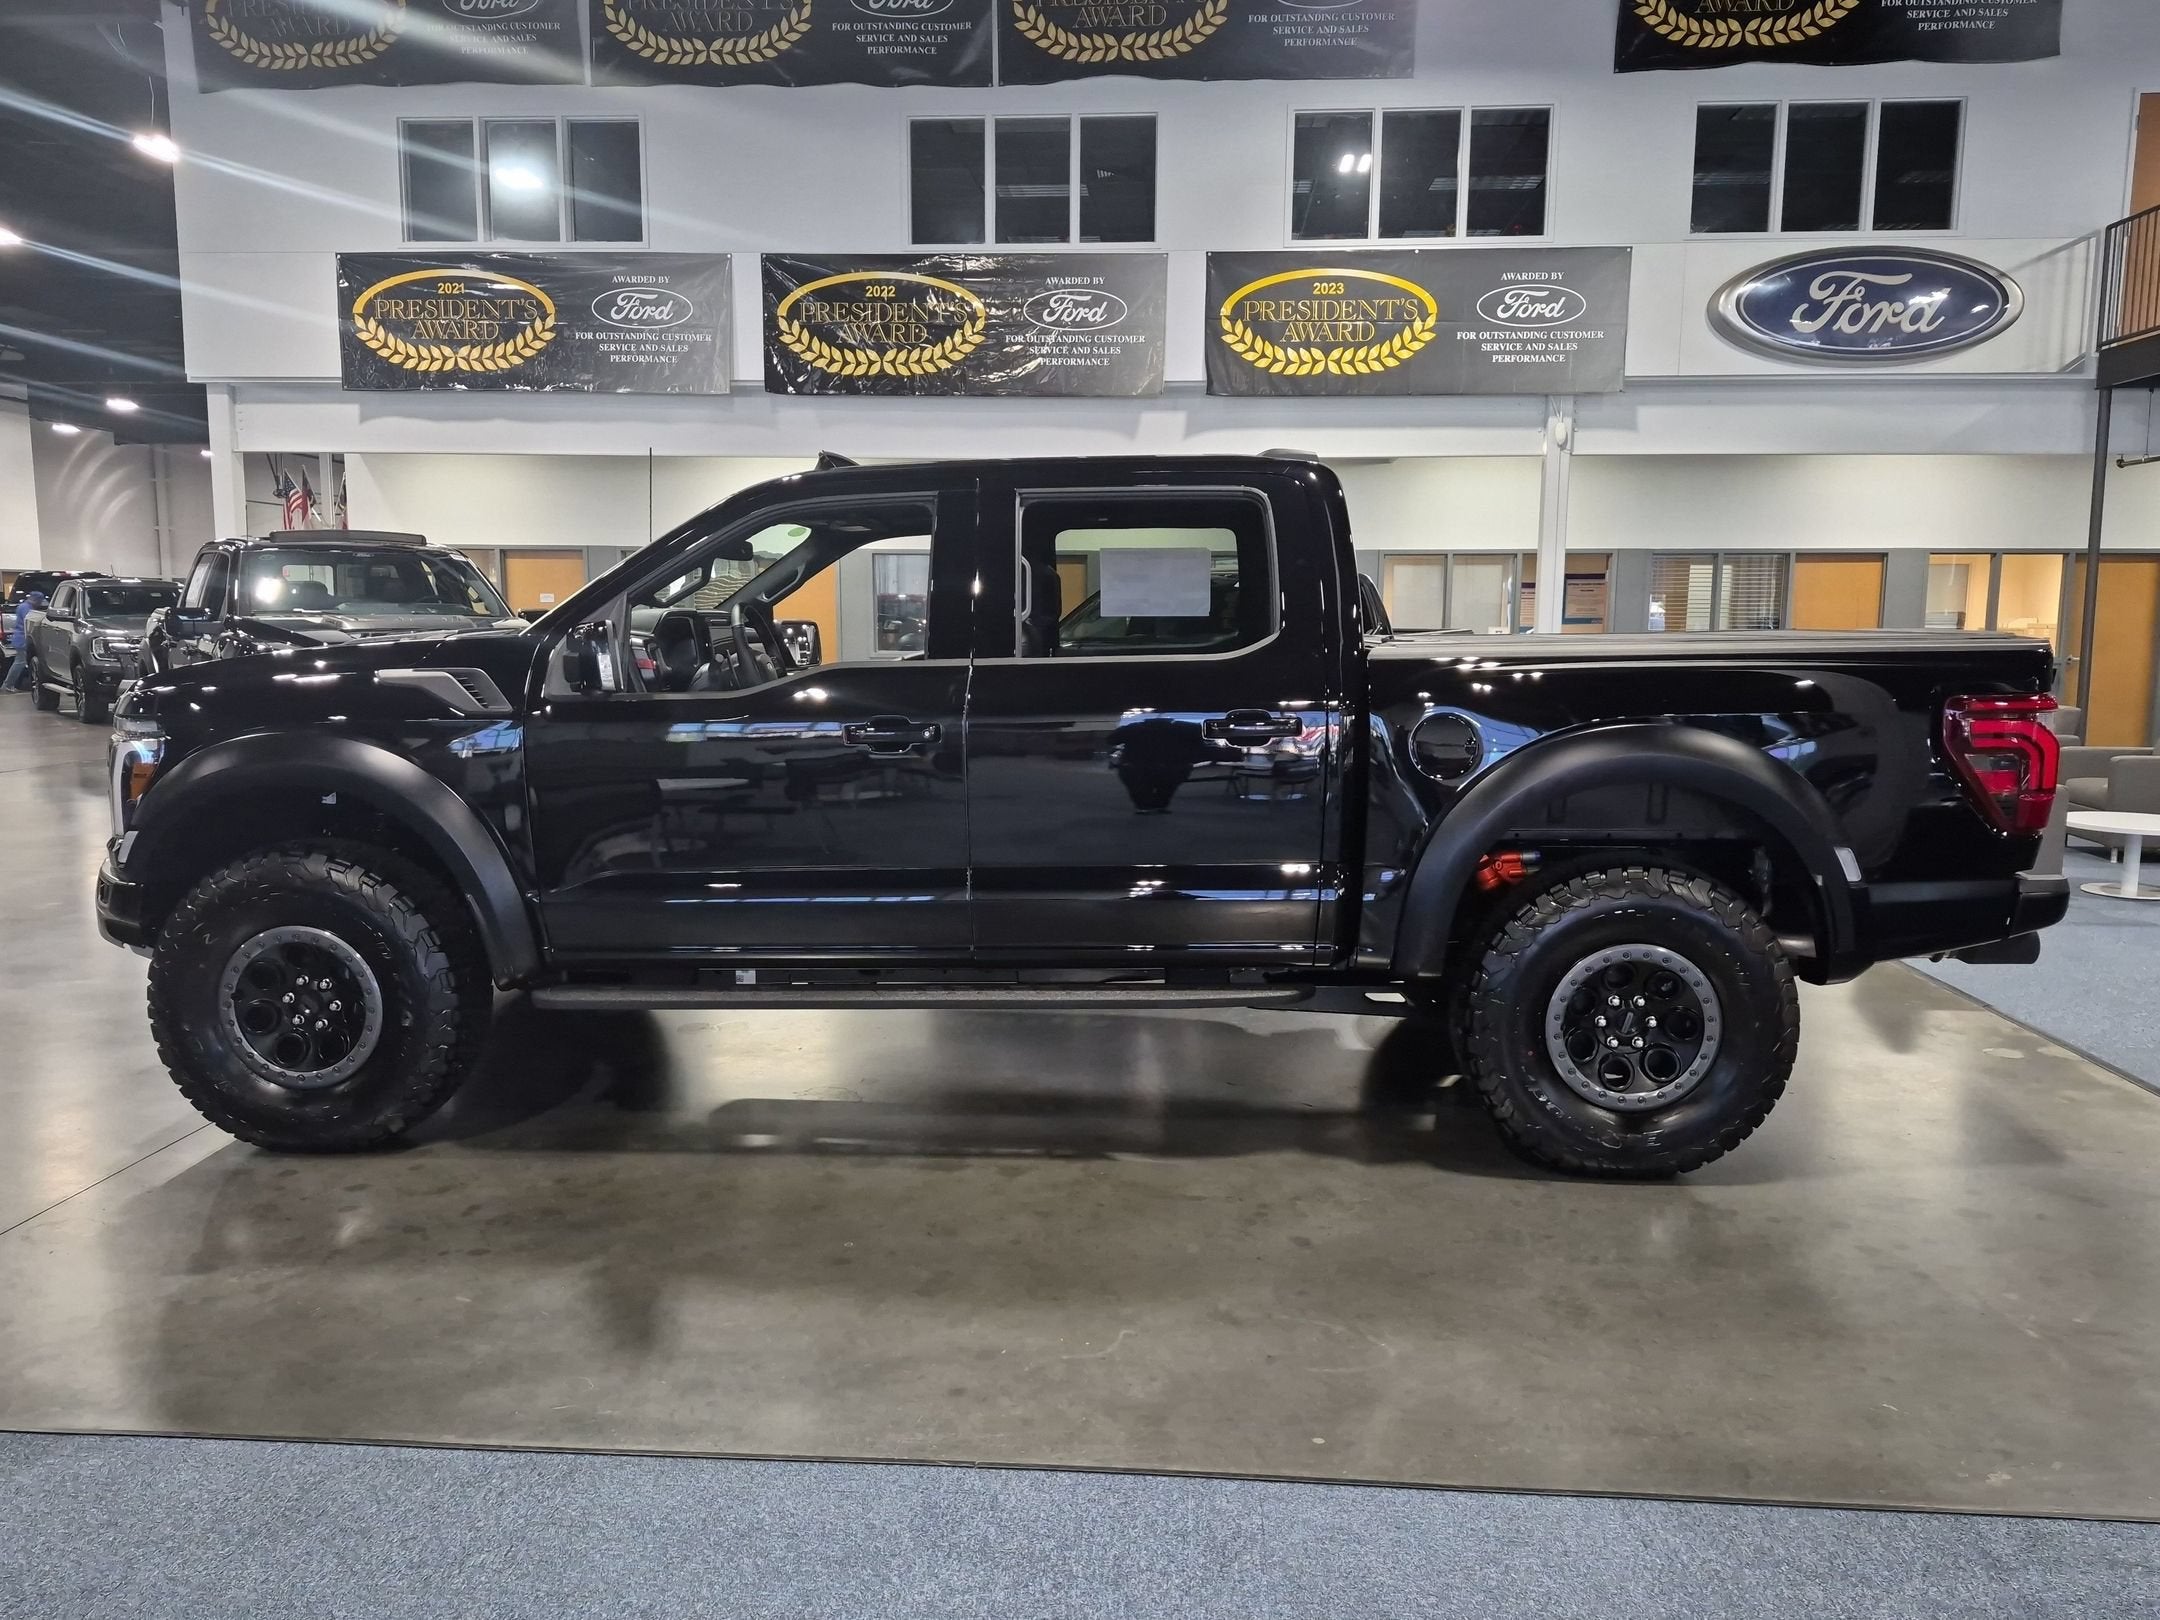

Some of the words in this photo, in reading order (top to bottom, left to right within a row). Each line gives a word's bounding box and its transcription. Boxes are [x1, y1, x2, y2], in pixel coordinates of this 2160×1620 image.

[1072, 5, 1167, 29] AWARD
[1248, 14, 1268, 23] FOR
[1270, 13, 1338, 22] OUTSTANDING
[1341, 12, 1395, 21] CUSTOMER
[1906, 9, 1951, 19] SERVICE
[1954, 8, 1976, 17] AND
[1978, 8, 2009, 17] SALES
[510, 21, 561, 31] CUSTOMER
[663, 11, 753, 32] AWARD
[832, 22, 851, 31] FOR
[853, 22, 919, 31] OUTSTANDING
[921, 21, 972, 31] CUSTOMER
[1917, 20, 1995, 31] PERFORMANCE
[1273, 26, 1314, 35] SERVICE
[1316, 25, 1337, 34] AND
[1339, 24, 1369, 33] SALES
[492, 34, 509, 43] AND
[511, 33, 537, 42] SALES
[856, 34, 895, 43] SERVICE
[898, 34, 917, 43] AND
[919, 35, 948, 43] SALES
[1284, 37, 1358, 47] PERFORMANCE
[461, 47, 529, 55] PERFORMANCE
[867, 46, 937, 55] PERFORMANCE
[612, 275, 656, 284] AWARDED
[658, 275, 671, 284] BY
[1045, 276, 1091, 285] AWARDED
[1093, 276, 1105, 285] BY
[1501, 272, 1549, 281] AWARDED
[1550, 272, 1564, 280] BY
[437, 282, 465, 294] 2021
[865, 286, 896, 297] 2022
[1312, 282, 1345, 295] 2023
[610, 292, 674, 320] Ford
[1496, 289, 1566, 319] Ford
[1792, 270, 1952, 334] Ford
[374, 299, 538, 320] PRESIDENT'S
[799, 302, 968, 323] PRESIDENT'S
[1042, 294, 1107, 322] Ford
[1242, 298, 1418, 322] PRESIDENT'S
[410, 319, 499, 340] AWARD
[836, 323, 927, 344] AWARD
[1280, 321, 1375, 343] AWARD
[575, 332, 594, 340] FOR
[595, 332, 659, 341] OUTSTANDING
[661, 333, 712, 342] CUSTOMER
[1005, 334, 1025, 343] FOR
[1027, 334, 1092, 343] OUTSTANDING
[1094, 334, 1146, 343] CUSTOMER
[1456, 331, 1477, 340] FOR
[1479, 331, 1548, 340] OUTSTANDING
[1550, 330, 1604, 339] CUSTOMER
[599, 343, 637, 351] SERVICE
[639, 344, 659, 352] AND
[660, 344, 689, 353] SALES
[1029, 346, 1069, 355] SERVICE
[1071, 346, 1091, 354] AND
[1092, 346, 1121, 354] SALES
[1481, 343, 1523, 351] SERVICE
[1525, 343, 1546, 351] AND
[1547, 342, 1578, 351] SALES
[610, 354, 678, 364] PERFORMANCE
[1040, 357, 1110, 366] PERFORMANCE
[1492, 354, 1566, 363] PERFORMANCE
